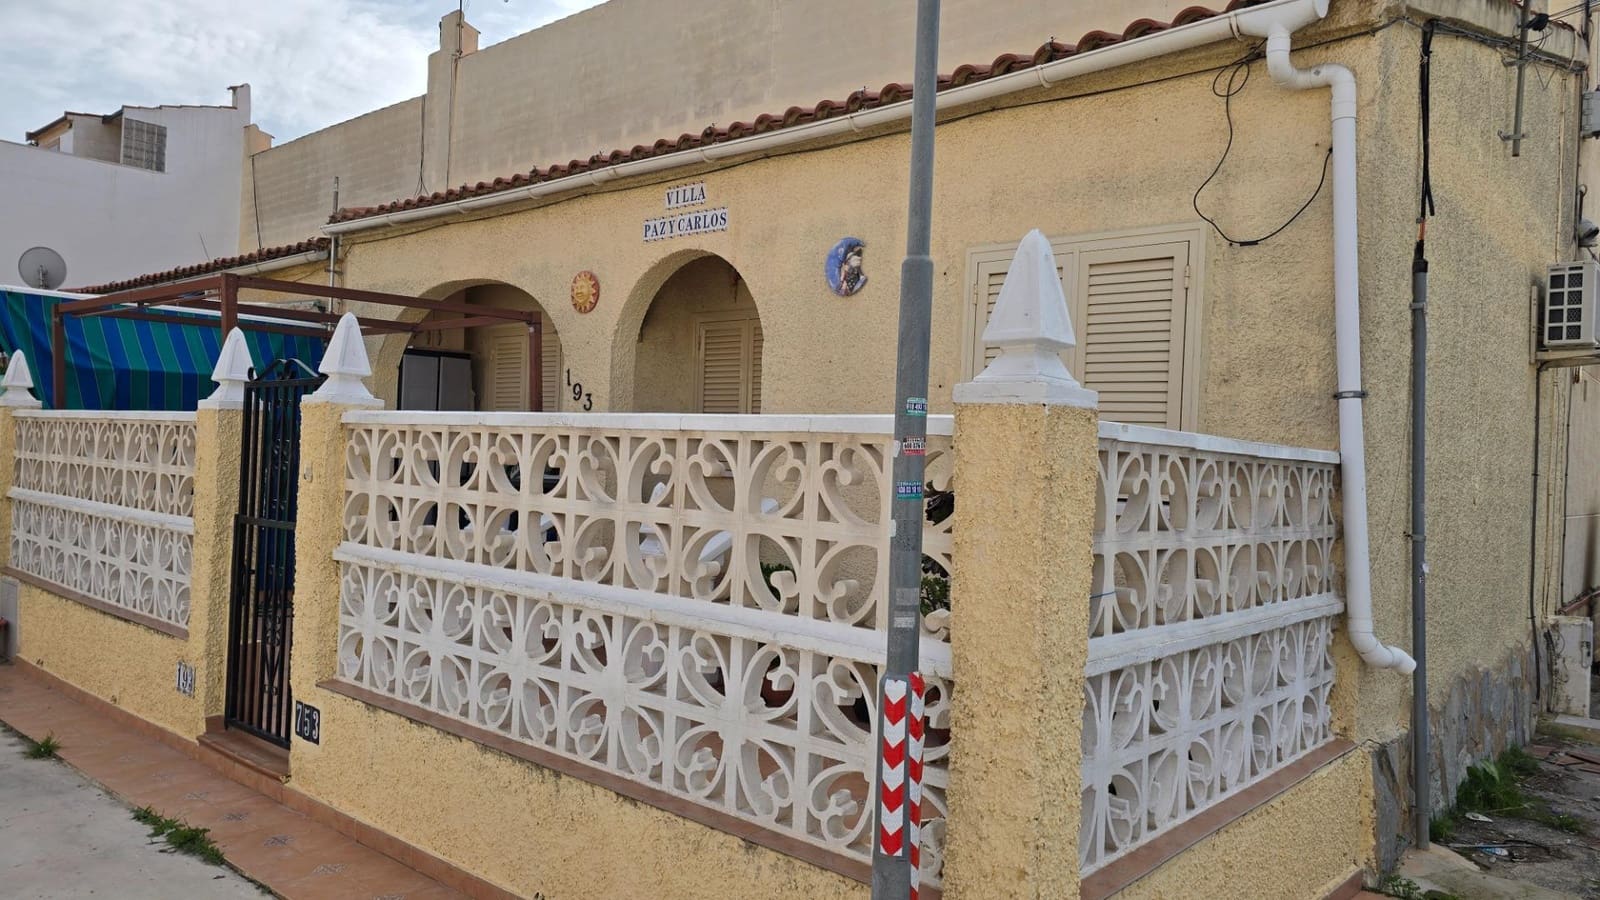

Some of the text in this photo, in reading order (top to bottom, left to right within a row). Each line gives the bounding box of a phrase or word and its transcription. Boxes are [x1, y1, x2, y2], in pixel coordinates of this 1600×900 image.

[666, 186, 706, 205] VILLA
[566, 368, 593, 411] 193
[296, 703, 319, 739] 753
